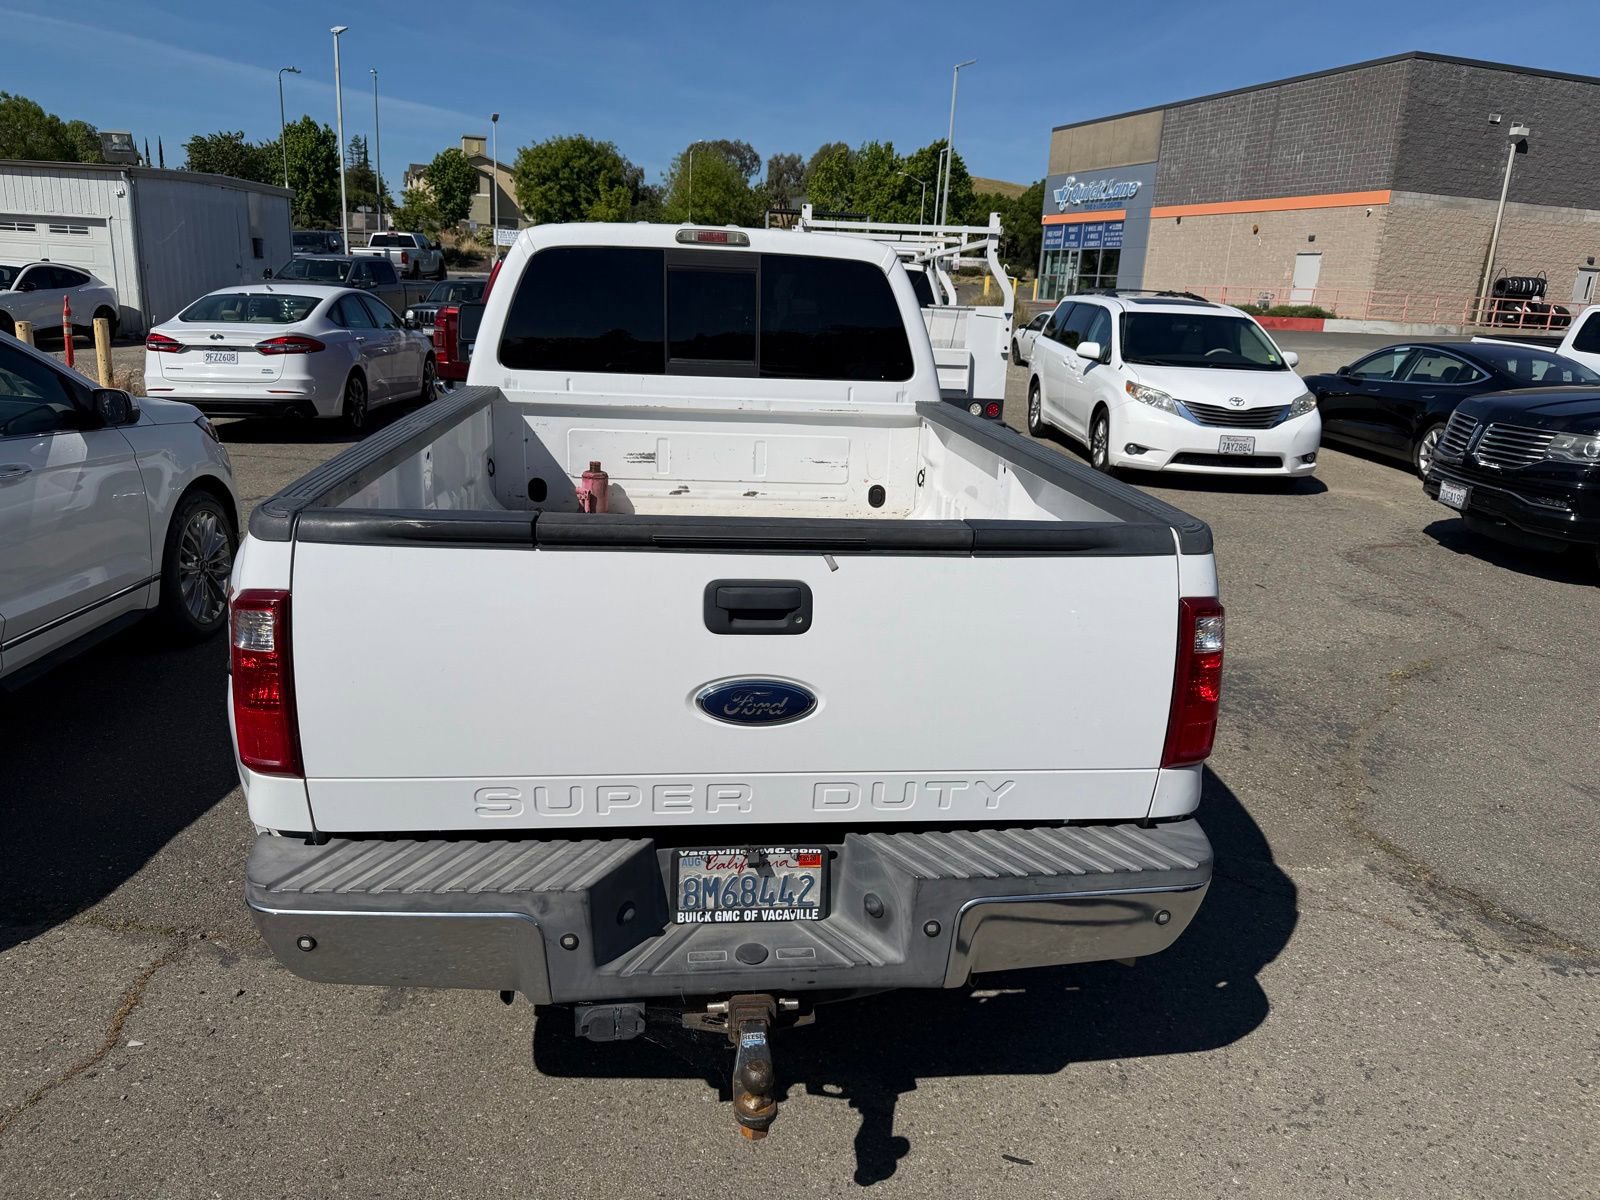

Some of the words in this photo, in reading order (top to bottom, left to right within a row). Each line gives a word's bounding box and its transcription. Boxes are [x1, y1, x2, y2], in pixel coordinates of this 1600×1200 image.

[1070, 180, 1104, 204] Quick
[1103, 179, 1140, 199] Lane
[205, 352, 236, 362] 9FZZ608
[723, 690, 789, 715] Ford
[473, 783, 754, 818] SUPER
[811, 780, 1017, 813] DUTY
[678, 847, 822, 857] VacavilleMC.com
[682, 857, 701, 867] AUG
[683, 874, 815, 909] 8M68442
[677, 911, 712, 924] BUICK
[715, 910, 740, 922] GMC
[744, 910, 758, 922] OF
[761, 908, 819, 921] VACAVILLE
